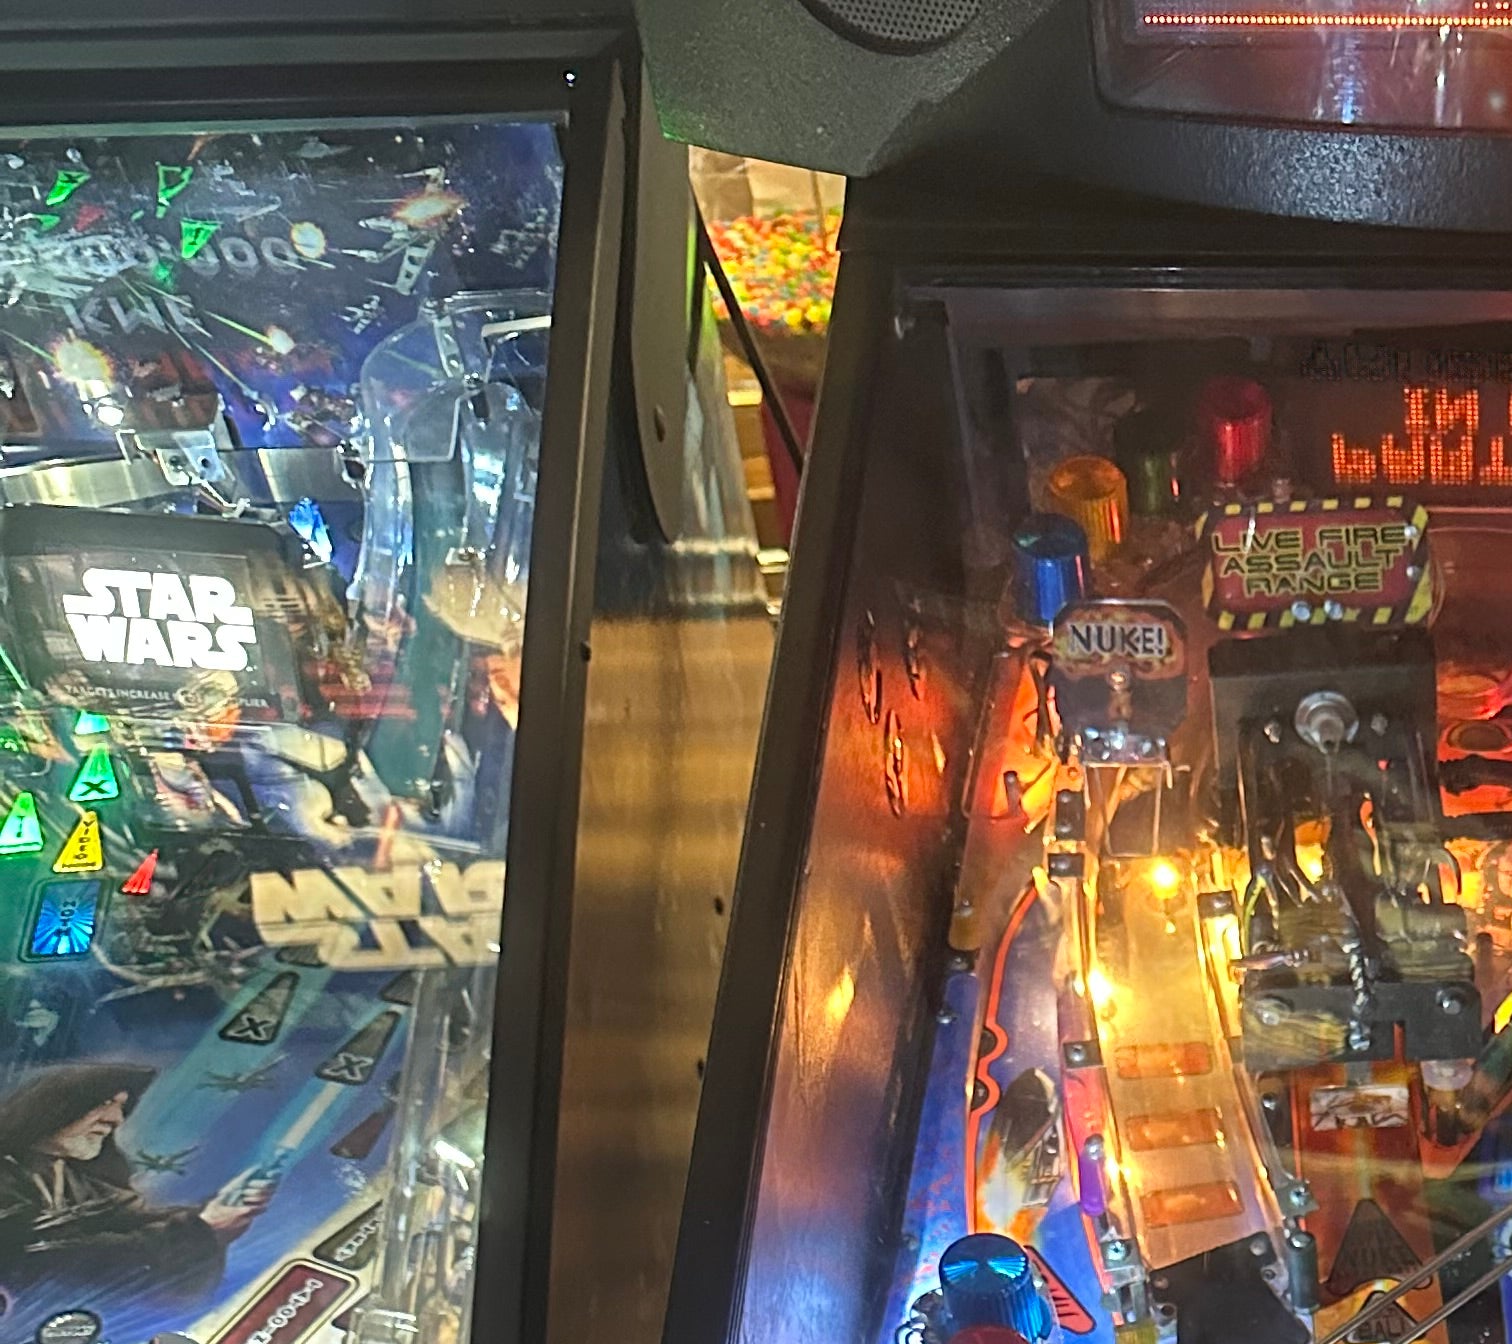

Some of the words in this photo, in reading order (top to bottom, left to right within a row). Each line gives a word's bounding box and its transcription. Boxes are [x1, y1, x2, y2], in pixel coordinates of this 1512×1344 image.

[1212, 531, 1302, 554] LIVE
[1317, 525, 1411, 549] FIRE
[1222, 549, 1403, 577] ASSAULT
[62, 567, 254, 626] STAR
[1244, 572, 1383, 598] RANGE
[65, 613, 257, 672] WARS
[1069, 624, 1168, 657] NUKE!
